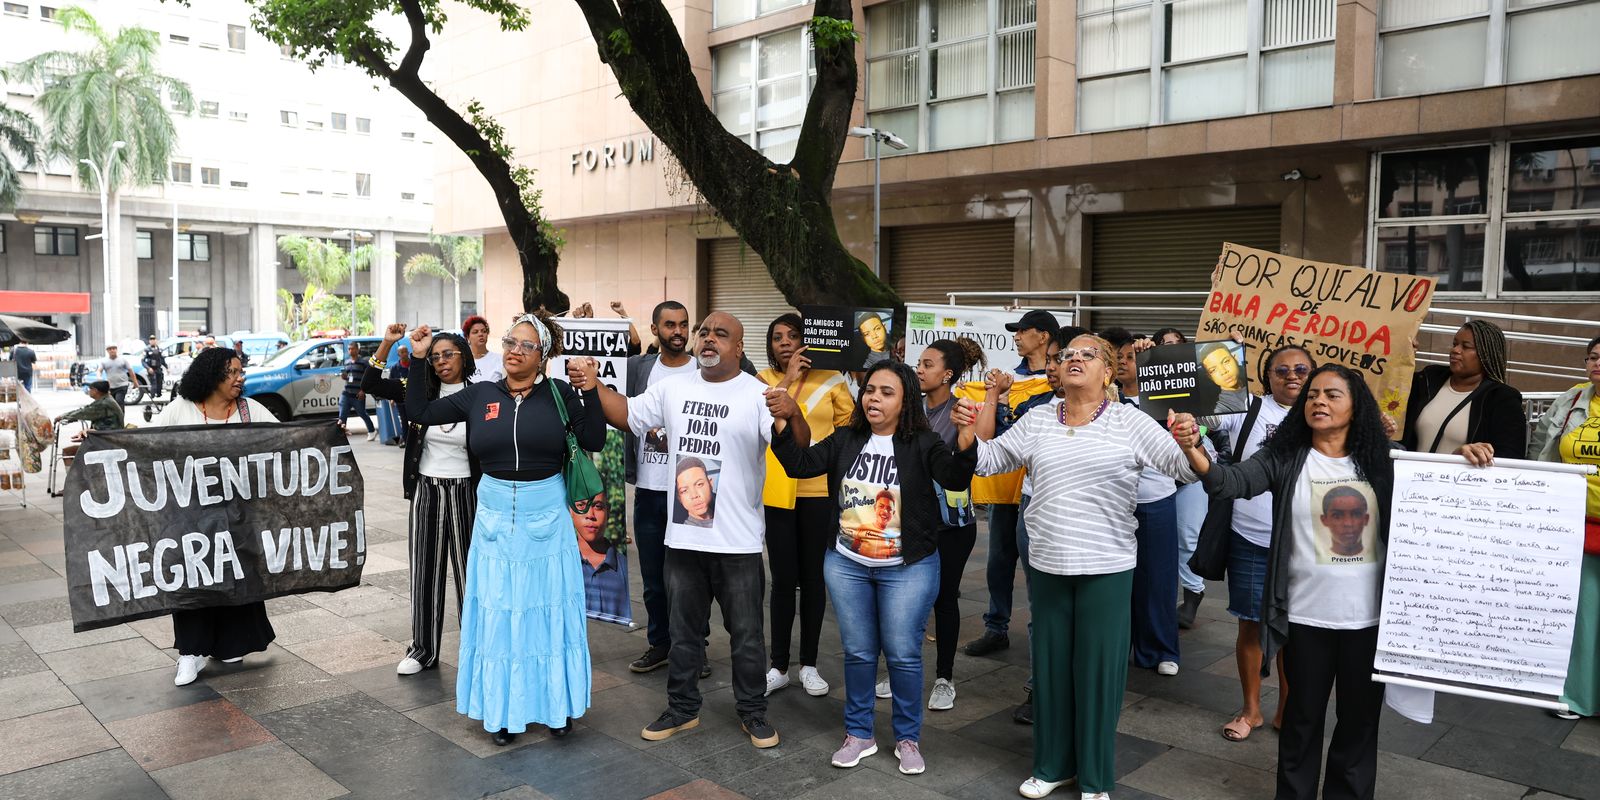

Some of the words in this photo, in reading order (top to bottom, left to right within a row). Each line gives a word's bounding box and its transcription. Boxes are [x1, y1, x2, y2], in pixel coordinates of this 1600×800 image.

[571, 136, 654, 175] FORUM
[1219, 249, 1281, 289] POR
[1300, 300, 1322, 315] DE
[803, 327, 818, 335] JOÃO
[818, 329, 838, 337] PEDRO
[804, 318, 812, 326] OS
[813, 319, 835, 328] AMIGOS
[836, 320, 844, 328] DE
[1203, 318, 1227, 334] SÃO
[1209, 292, 1261, 314] BALA
[1266, 302, 1391, 356] PERDIDA
[562, 330, 627, 356] USTIÇA
[803, 337, 825, 345] EXIGEM
[825, 338, 850, 348] JUSTIÇA!
[1138, 363, 1175, 378] JUSTIÇA
[1176, 361, 1196, 373] POR
[1139, 379, 1162, 392] JOÃO
[1164, 377, 1196, 390] PEDRO
[303, 396, 340, 408] POLÍC
[681, 400, 729, 419] ETERNO
[686, 418, 718, 437] JOÃO
[678, 436, 721, 456] PEDRO
[641, 452, 669, 465] JUSTI
[846, 452, 900, 491] USTIÇ
[79, 445, 352, 519] JUVENTUDE
[88, 530, 245, 607] NEGRA
[261, 509, 365, 574] VIVE!
